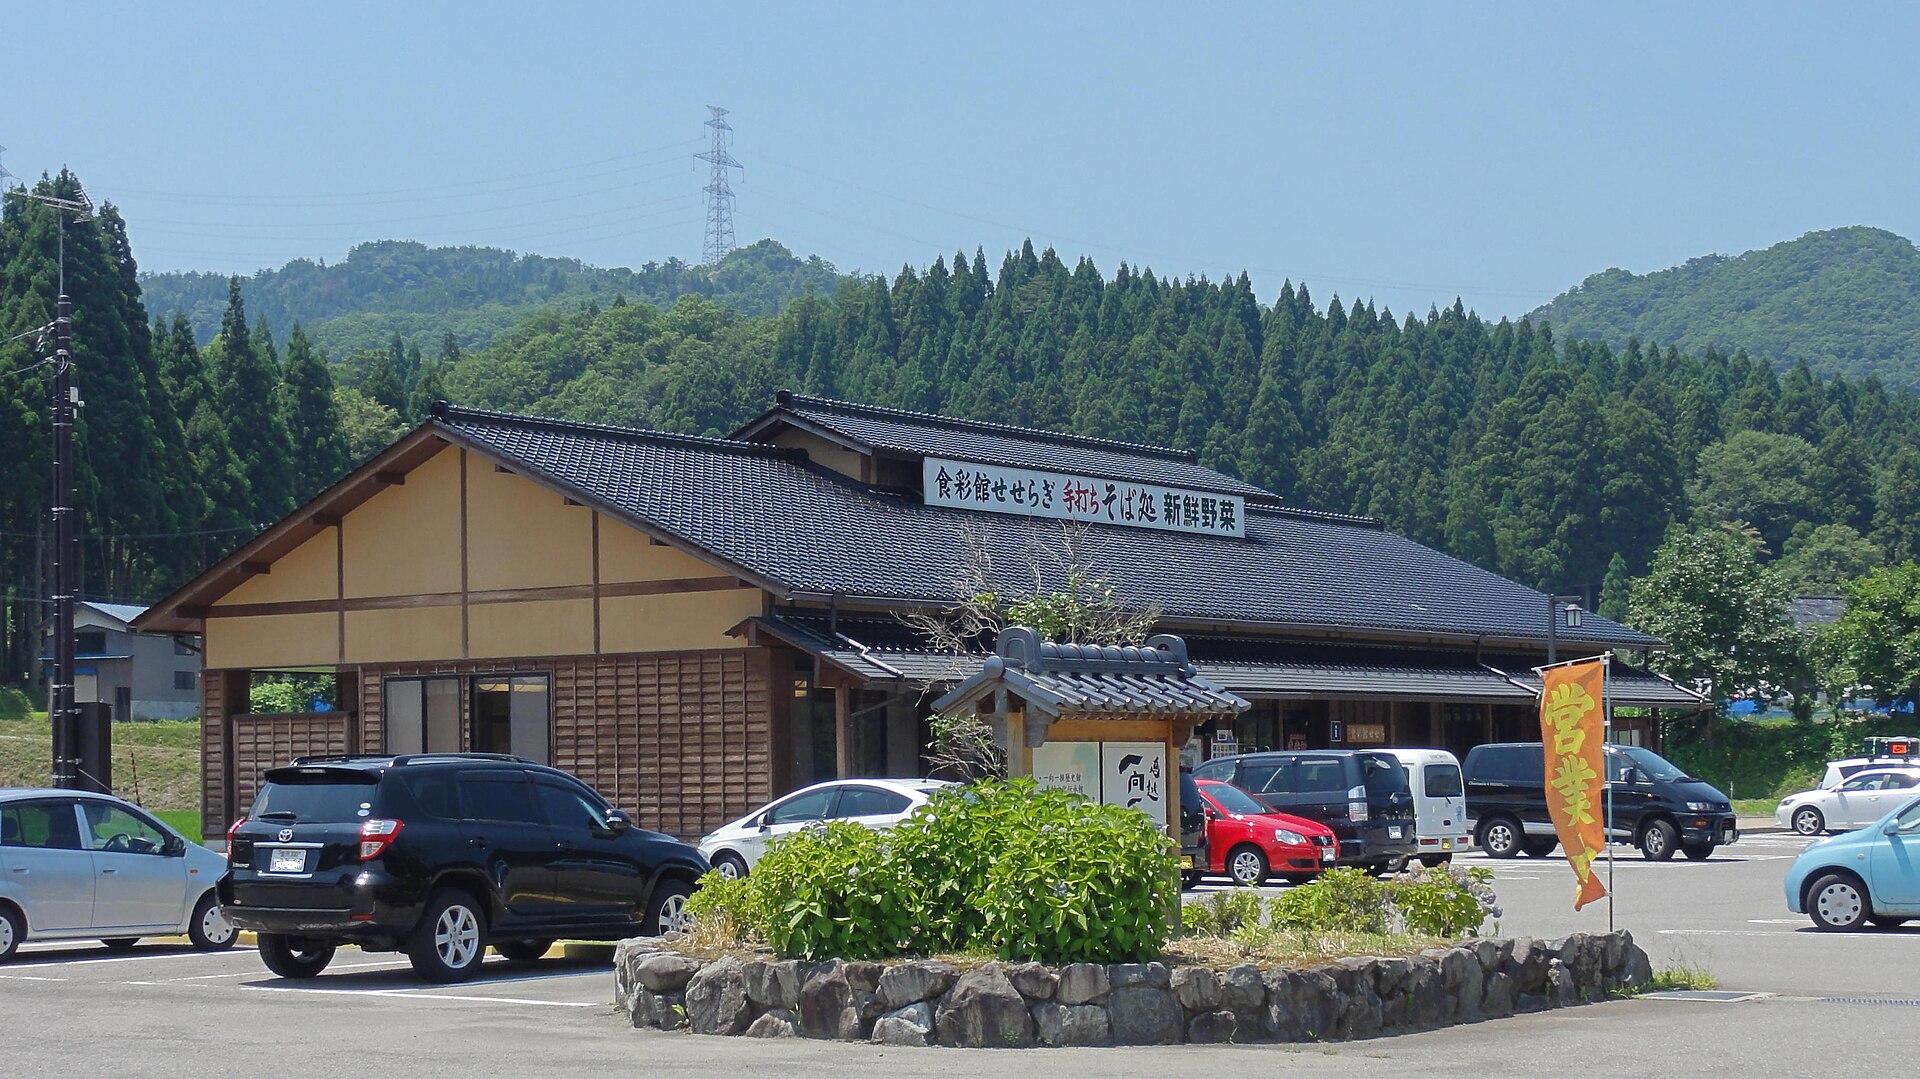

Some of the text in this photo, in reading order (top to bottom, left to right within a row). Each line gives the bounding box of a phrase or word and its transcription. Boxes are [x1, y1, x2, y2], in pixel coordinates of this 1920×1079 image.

[934, 465, 1236, 532] 食彩館せせらぎ 手打ちそば処 新鮮野菜
